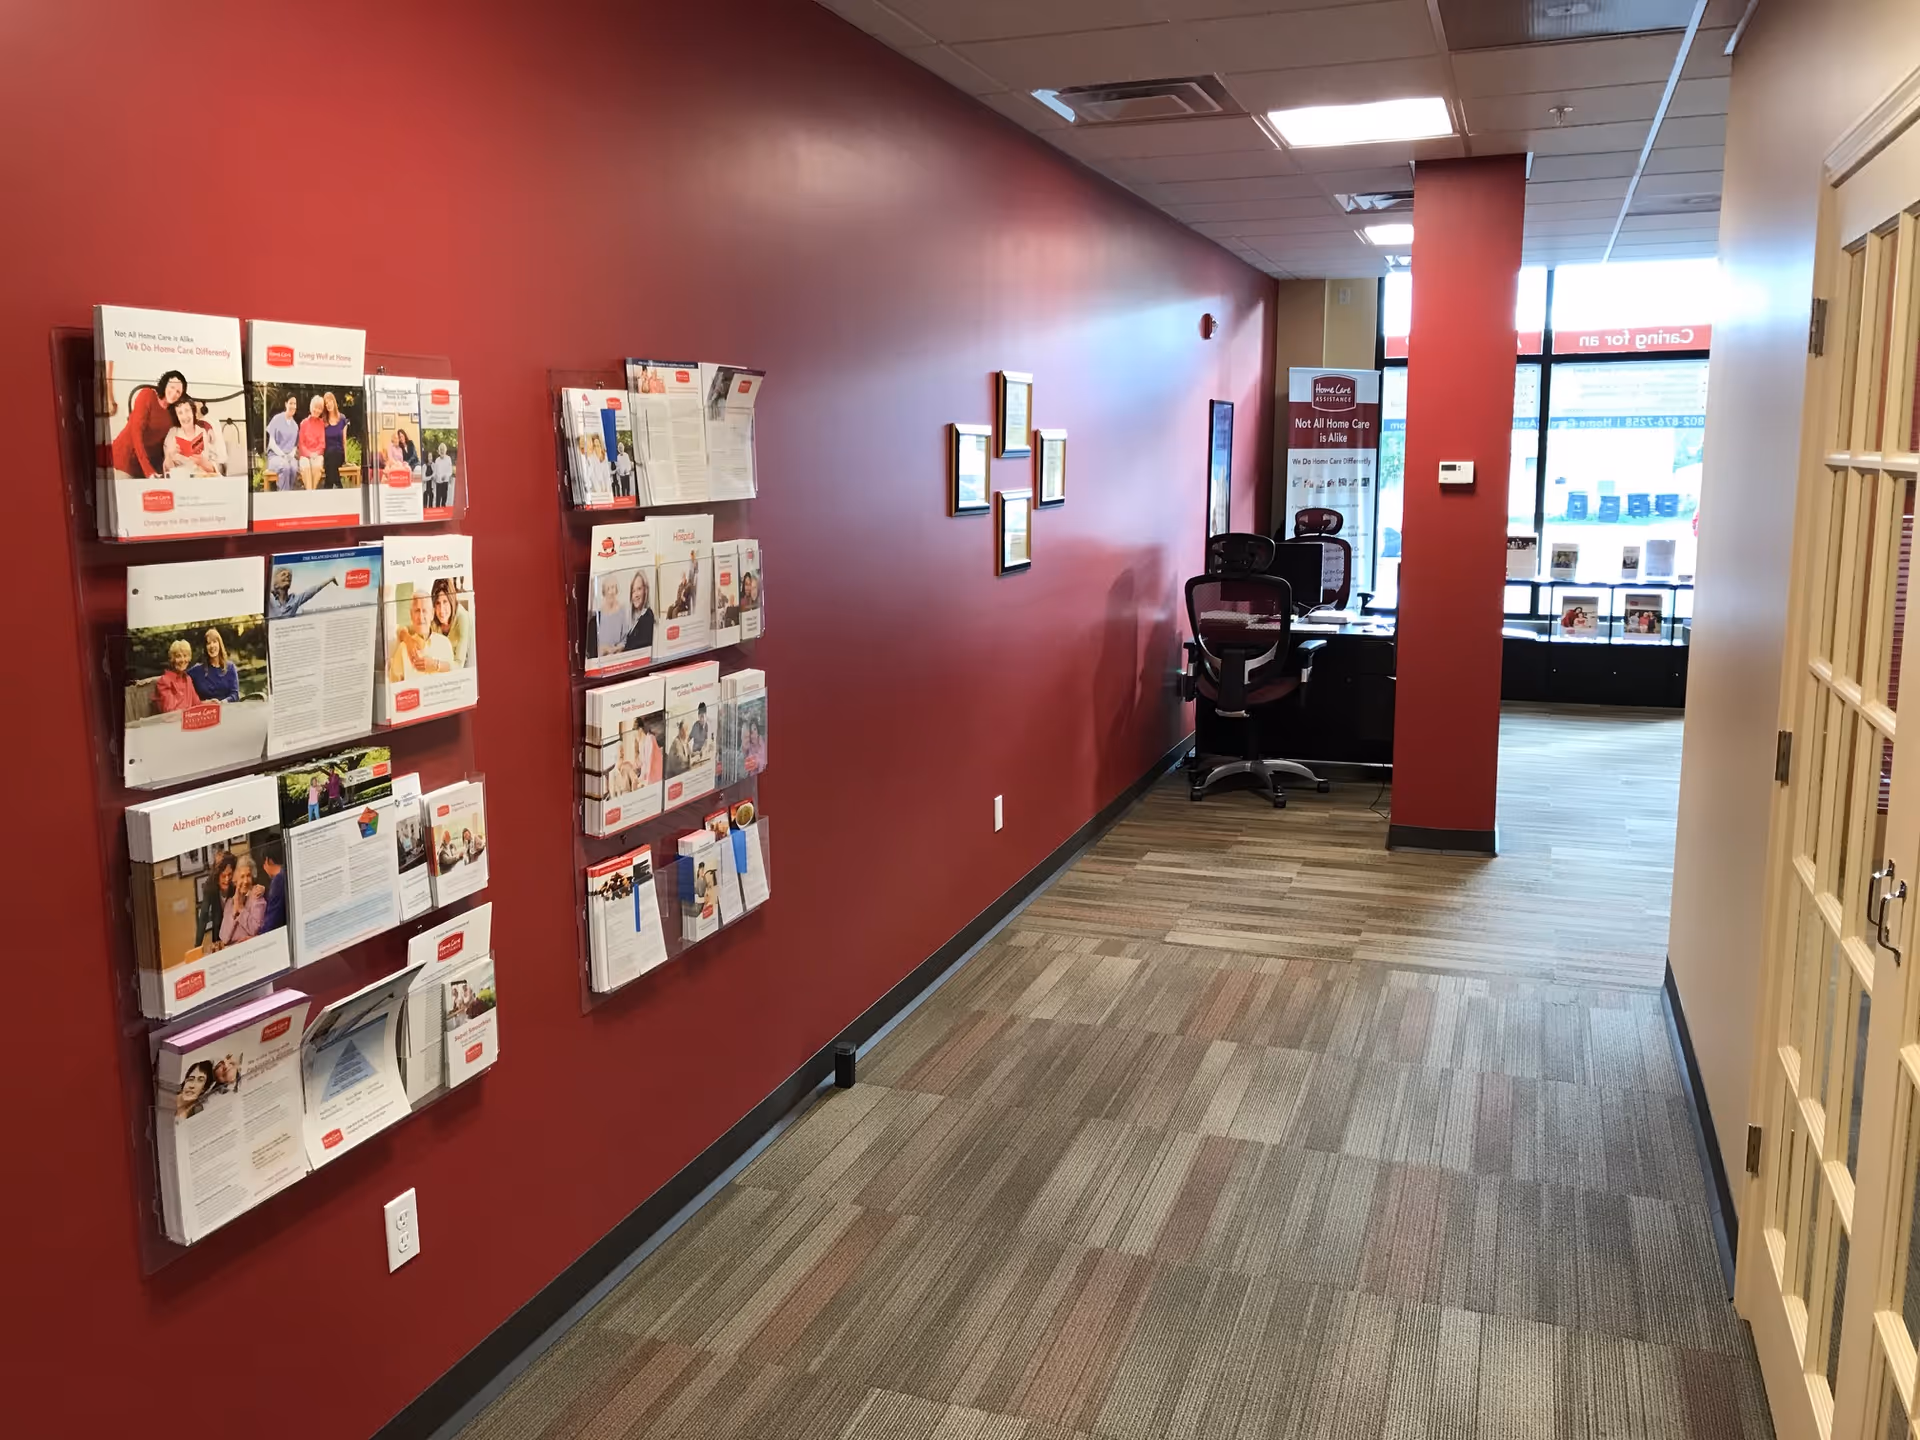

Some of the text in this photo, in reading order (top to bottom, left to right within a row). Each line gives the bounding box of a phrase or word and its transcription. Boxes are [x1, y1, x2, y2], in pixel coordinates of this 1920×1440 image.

[114, 330, 127, 338] Not
[138, 332, 156, 340] Home
[126, 342, 231, 359] We Do Home Care Differently
[298, 351, 315, 361] Living
[316, 353, 328, 361] Well
[336, 354, 352, 362] Home
[1315, 383, 1351, 394] Home Care
[1295, 418, 1370, 429] Not All Home Care
[1319, 433, 1348, 443] is Alike
[1343, 457, 1371, 467] Differently
[390, 559, 406, 568] Talking
[411, 556, 426, 564] Your
[427, 554, 450, 563] Parents
[164, 593, 186, 601] Balanced
[202, 708, 217, 716] Care
[172, 808, 234, 832] Alzheimer's and
[205, 813, 261, 835] Dementia Care
